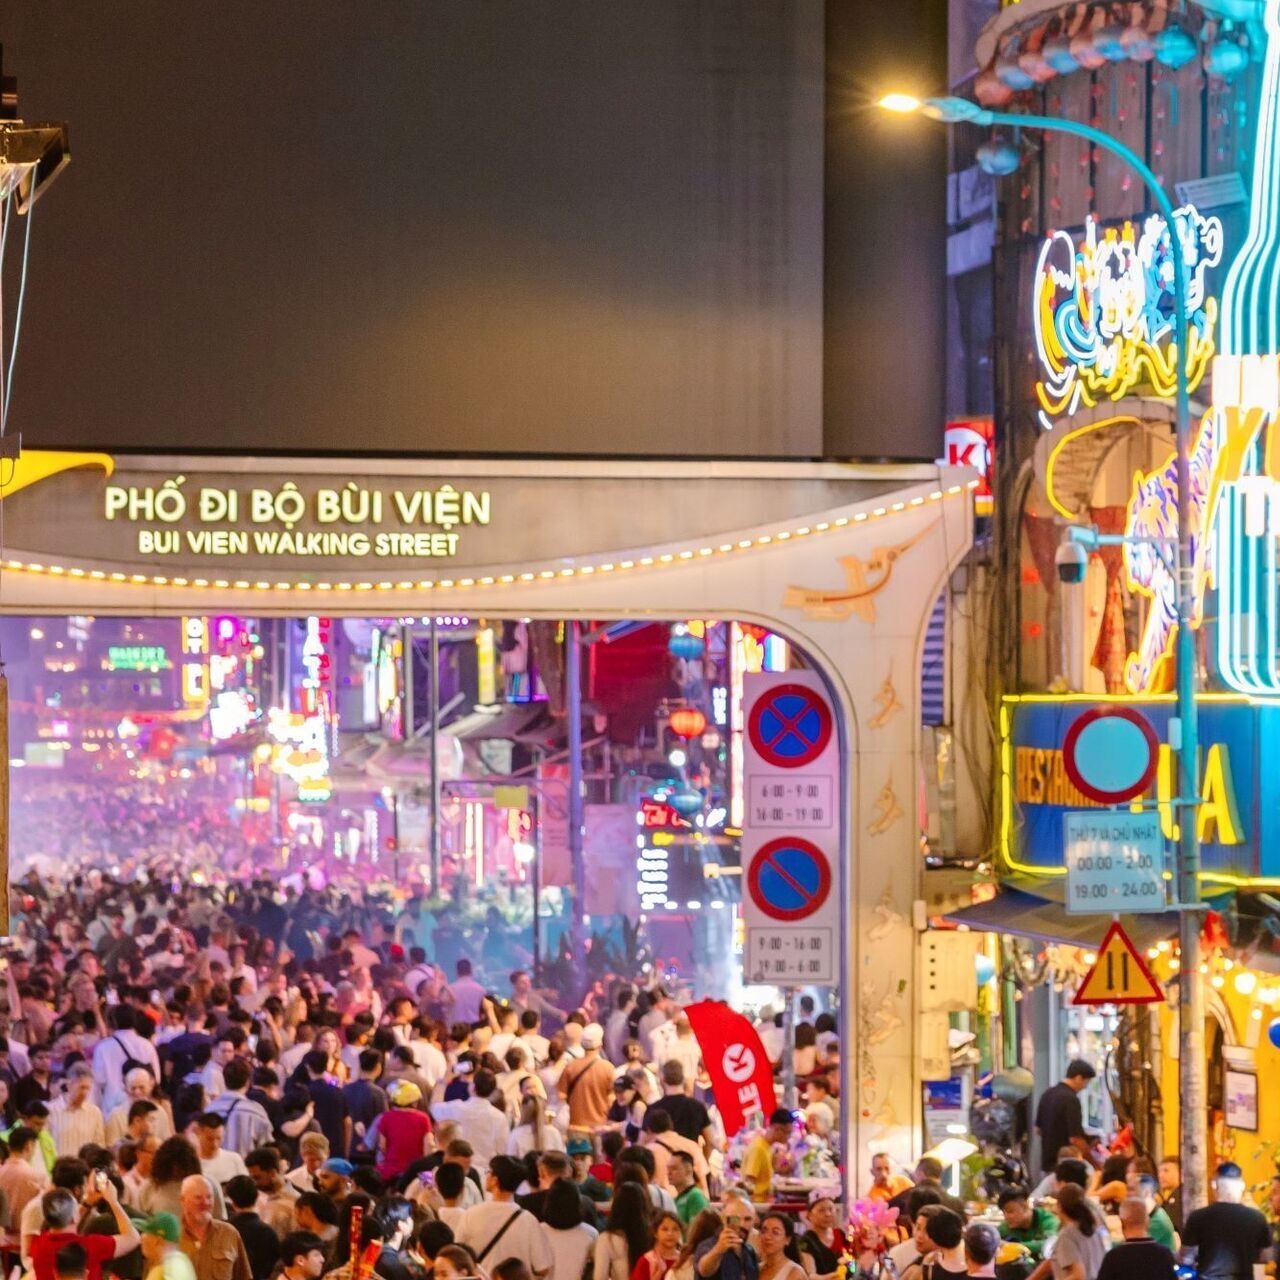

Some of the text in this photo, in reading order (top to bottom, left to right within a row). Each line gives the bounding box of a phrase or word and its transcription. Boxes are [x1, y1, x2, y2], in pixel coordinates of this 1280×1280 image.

[105, 475, 491, 530] PHỐ ĐI BỘ BÙI VIỆN
[138, 530, 459, 557] BUI VIEN WALKING STREET
